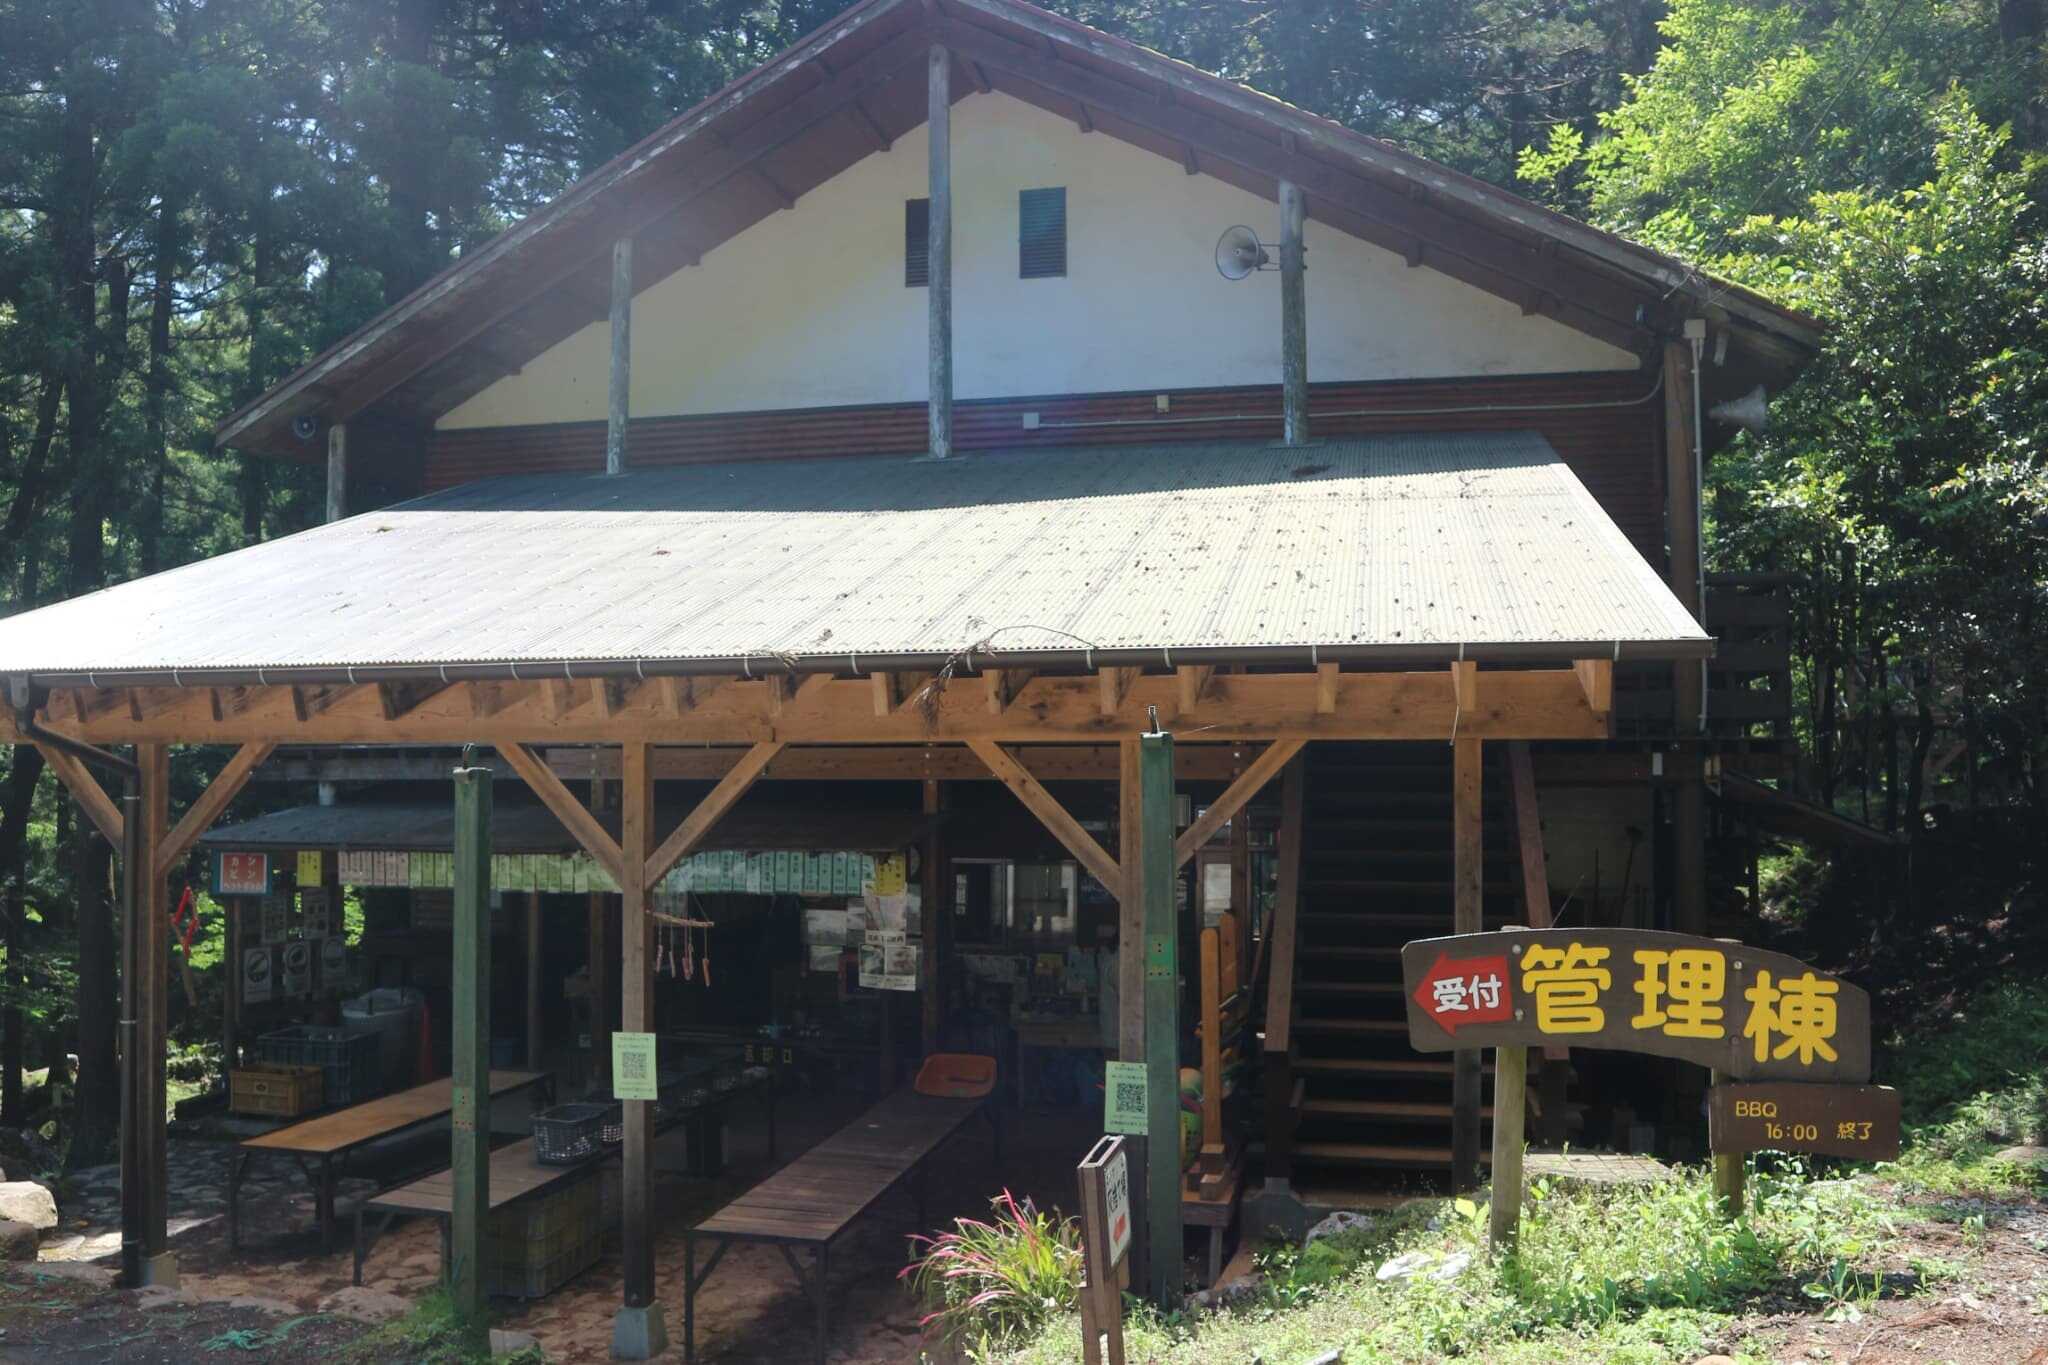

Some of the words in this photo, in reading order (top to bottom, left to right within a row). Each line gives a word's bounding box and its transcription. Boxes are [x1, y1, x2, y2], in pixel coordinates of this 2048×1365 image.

[1432, 973, 1503, 1013] 受付
[1520, 941, 1839, 1066] 管理棟
[1735, 1100, 1777, 1118] BBQ
[1765, 1122, 1818, 1141] 16:00
[1837, 1121, 1873, 1140] 終了
